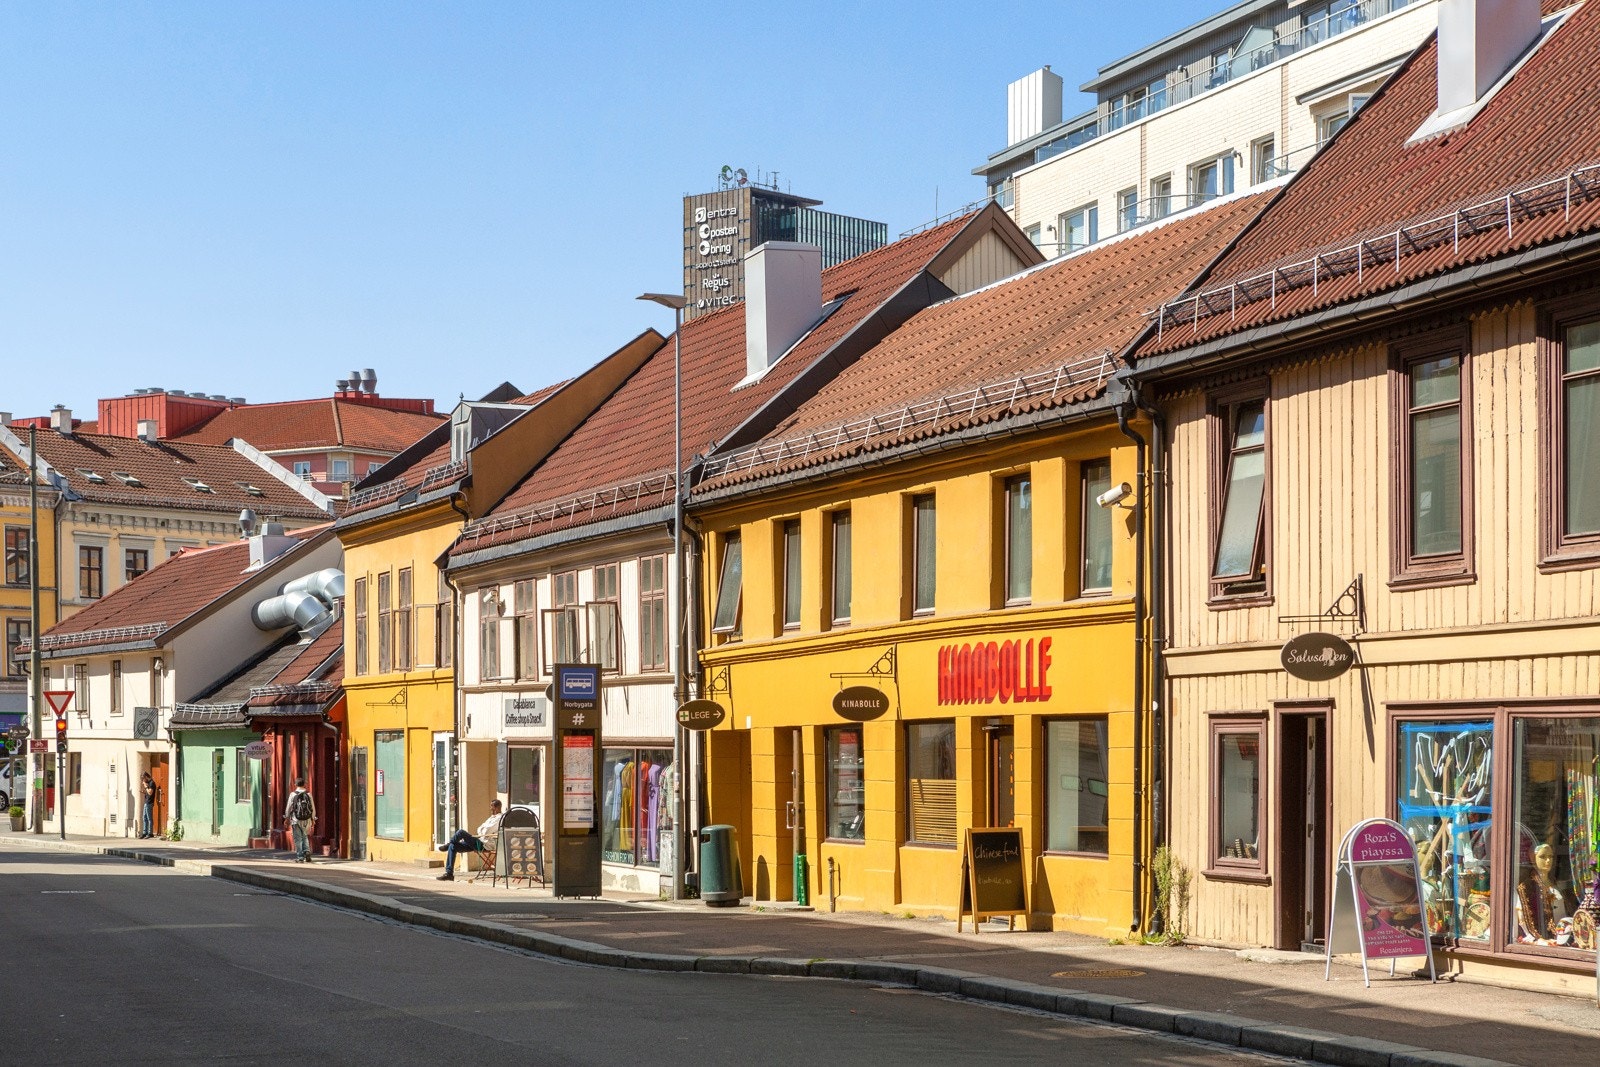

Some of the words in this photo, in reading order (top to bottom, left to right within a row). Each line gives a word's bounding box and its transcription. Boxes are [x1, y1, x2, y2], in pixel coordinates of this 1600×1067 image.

[707, 207, 737, 218] entra
[711, 226, 738, 239] posten
[711, 243, 731, 254] bring
[702, 277, 729, 291] Regus
[938, 636, 1052, 706] KINABOLLE
[512, 698, 536, 710] Casablanca
[564, 701, 593, 709] Norbygata
[841, 699, 880, 708] KINABOLLE
[690, 710, 710, 720] LEGE
[974, 843, 1003, 859] Chinese
[1002, 841, 1019, 862] food
[1360, 847, 1404, 860] piayssa
